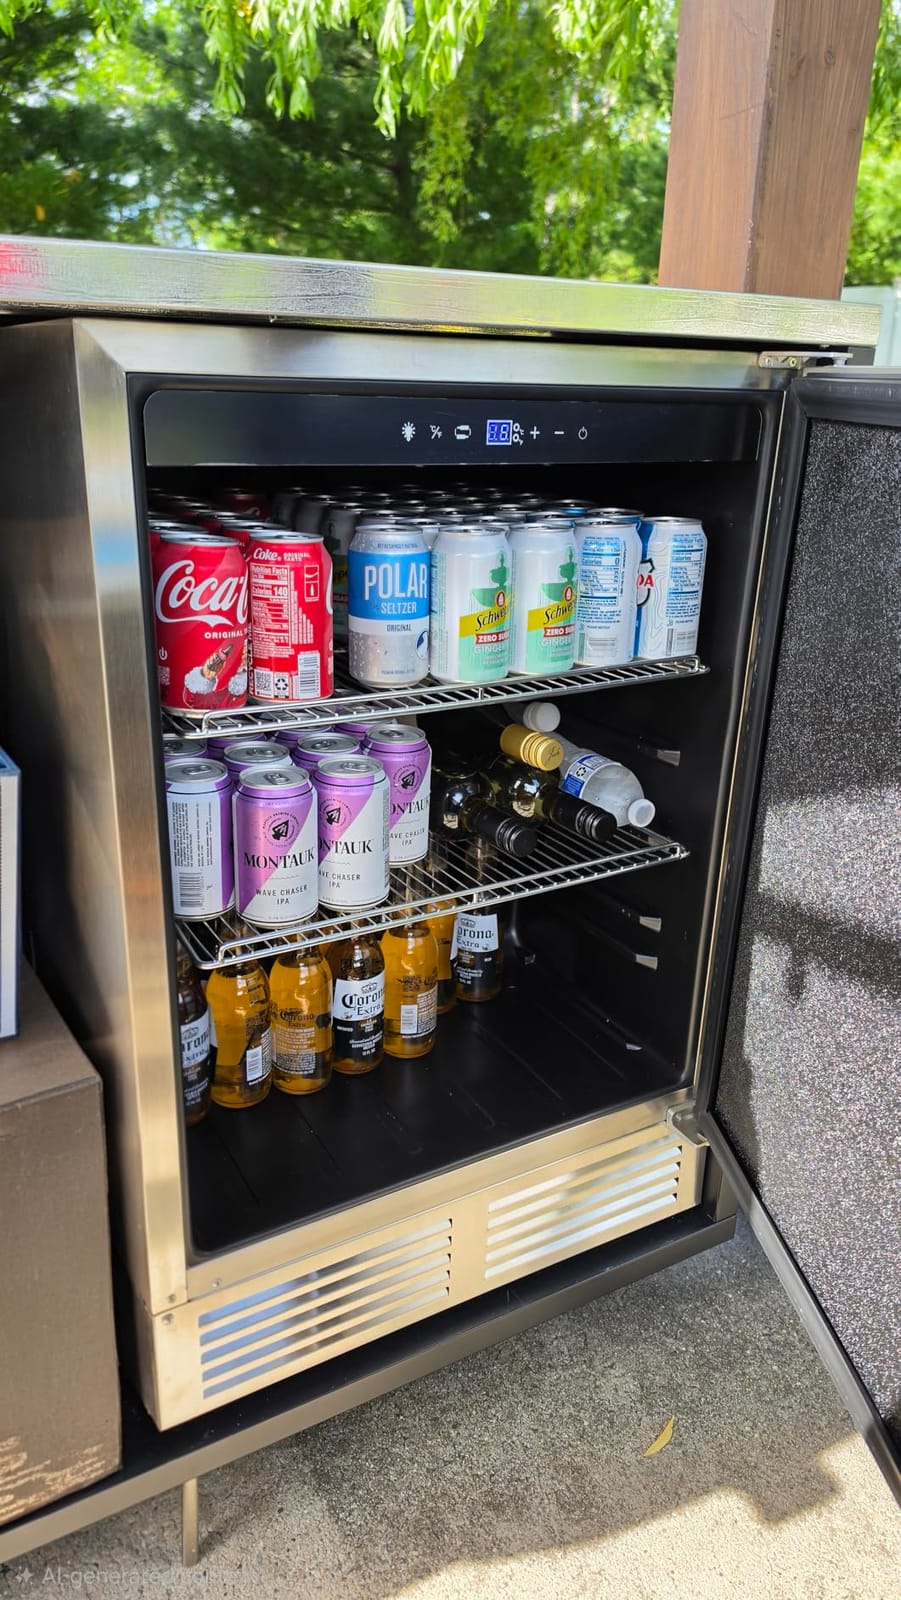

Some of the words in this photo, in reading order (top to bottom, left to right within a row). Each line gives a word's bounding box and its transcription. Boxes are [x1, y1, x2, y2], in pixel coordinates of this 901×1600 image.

[253, 547, 278, 561] Coke
[364, 562, 428, 600] POLAR
[273, 587, 288, 597] 140
[380, 601, 417, 614] SELTZER
[386, 624, 412, 632] ORIGINAL
[545, 628, 563, 636] ZERO
[204, 630, 243, 639] ORIGINAL
[478, 635, 497, 643] ZERO
[244, 847, 315, 869] MONTAUK
[331, 871, 361, 881] CHASER
[329, 881, 341, 889] IPA
[256, 888, 277, 897] WAVE
[280, 884, 308, 896] CHASER
[357, 1004, 381, 1016] Extra
